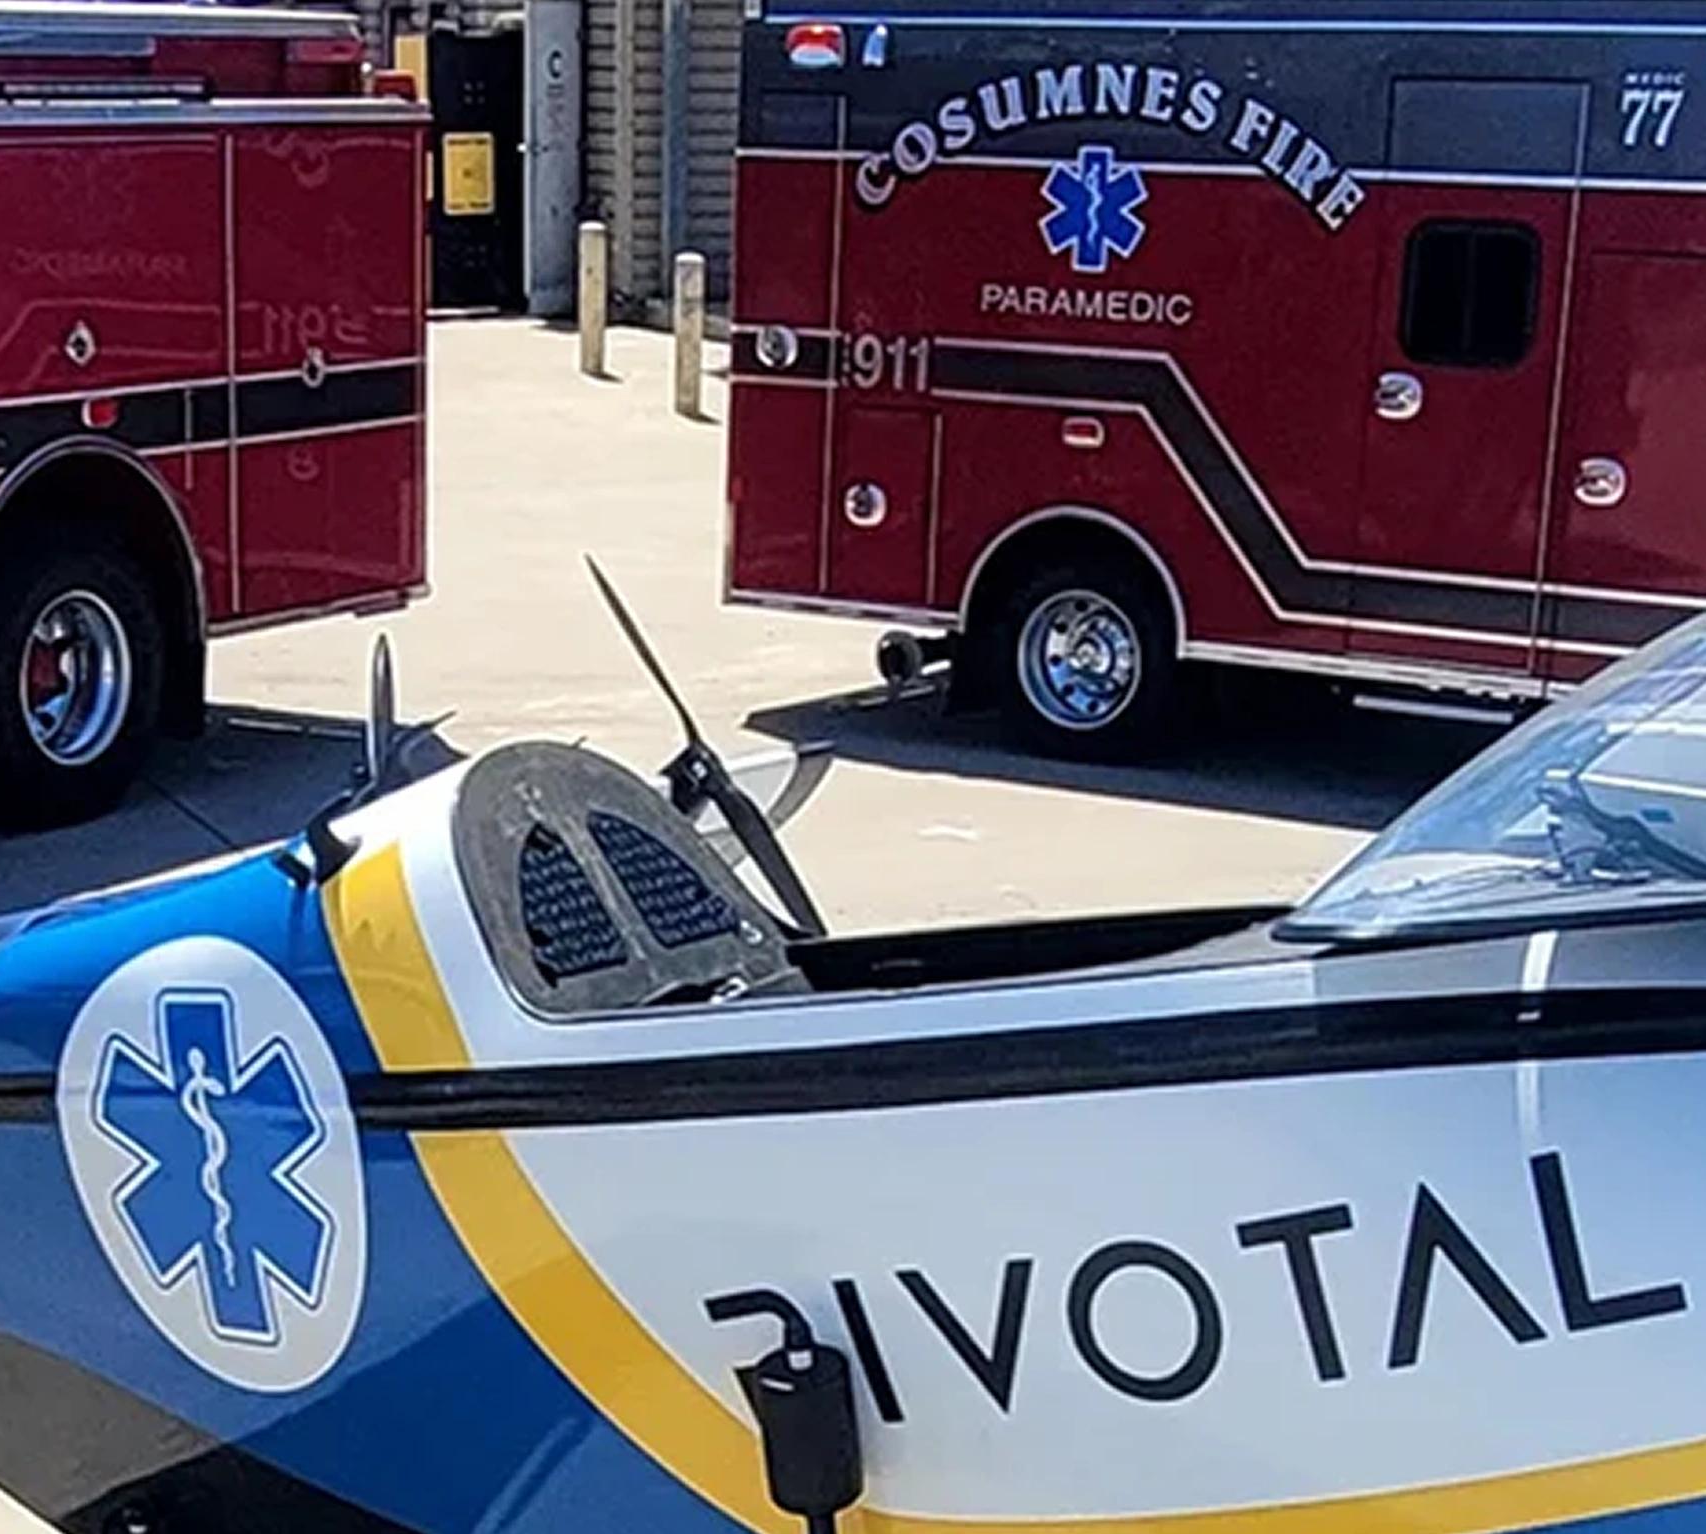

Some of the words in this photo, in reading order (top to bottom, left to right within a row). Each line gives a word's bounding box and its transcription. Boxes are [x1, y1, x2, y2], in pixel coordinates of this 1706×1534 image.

[856, 63, 1223, 205] COSUMNES
[1229, 99, 1366, 231] FIRE
[1621, 88, 1685, 147] 77
[980, 284, 1194, 324] PARAMEDIC
[853, 333, 931, 393] 911
